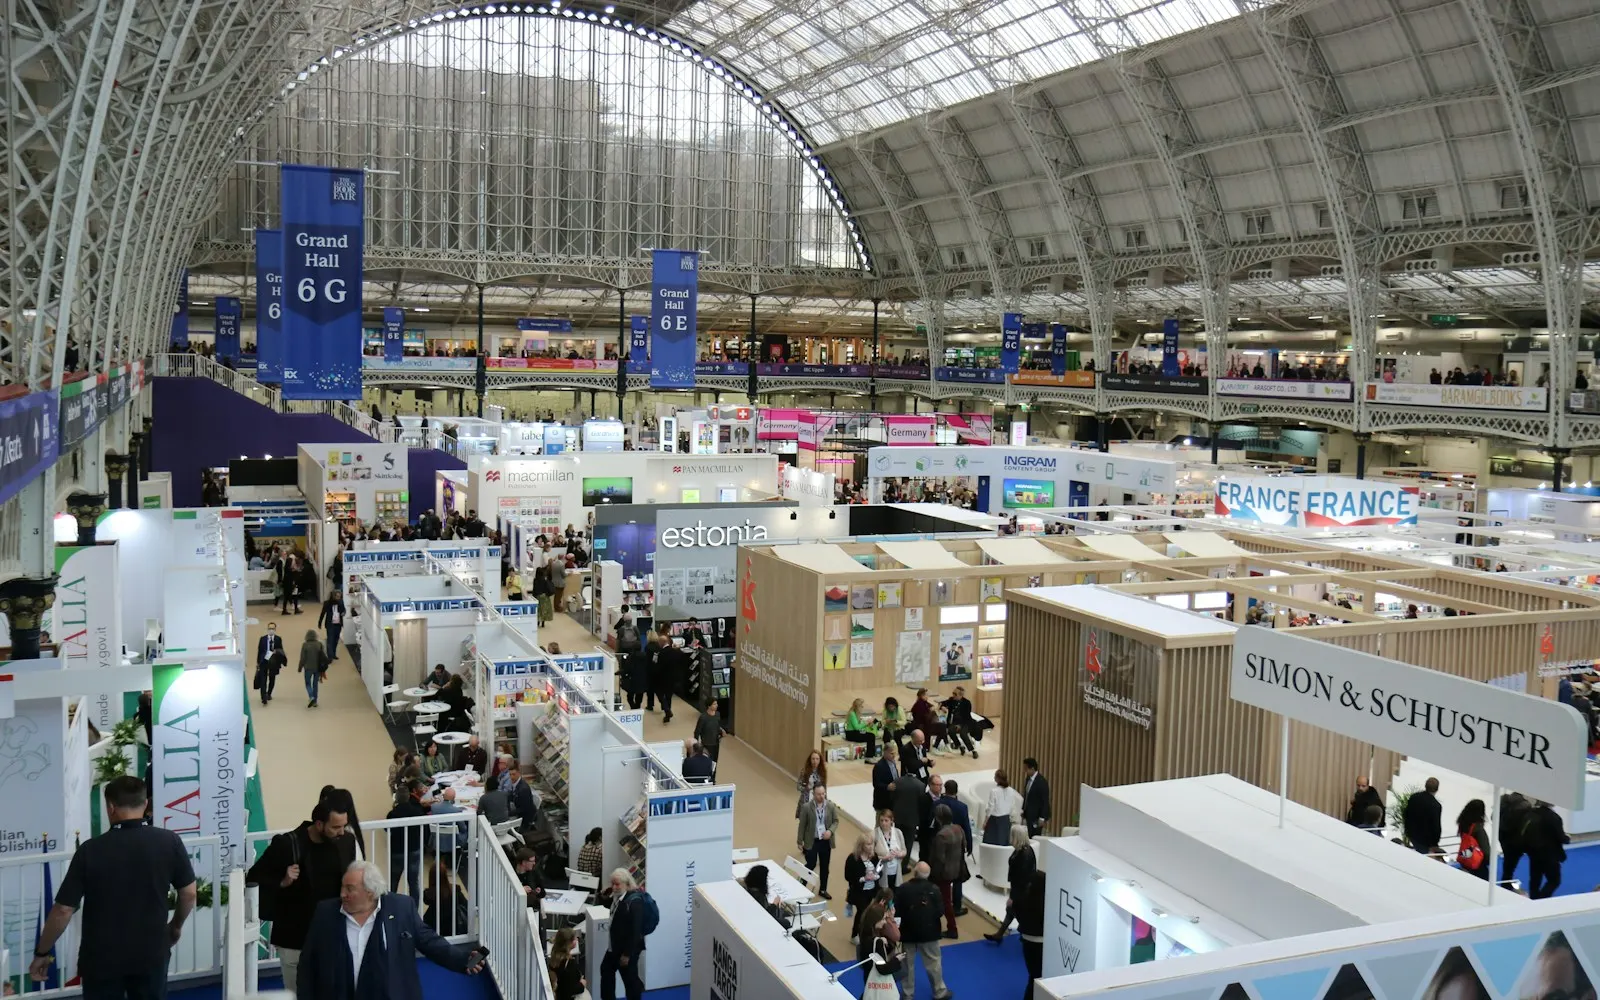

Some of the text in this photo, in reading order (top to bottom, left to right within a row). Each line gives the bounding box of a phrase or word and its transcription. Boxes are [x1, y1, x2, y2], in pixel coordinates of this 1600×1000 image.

[334, 185, 357, 194] BOOK
[333, 193, 357, 201] FAIR
[296, 232, 348, 248] Grand
[305, 253, 340, 268] Hall
[297, 277, 347, 303] 6 G
[660, 289, 689, 298] Grand
[664, 301, 684, 310] Hall
[660, 315, 688, 331] 6 E
[219, 327, 235, 335] 6 G
[1530, 341, 1542, 349] Lift
[1441, 387, 1523, 407] BARAMGILBOOKS
[763, 422, 797, 430] Germany
[890, 427, 927, 439] Germany
[1004, 455, 1057, 468] INGRAM
[508, 469, 575, 482] macmillan
[682, 465, 744, 474] PAN MACMILLAN
[1510, 465, 1523, 473] Lift
[1218, 481, 1300, 514] FRANCE
[1306, 490, 1411, 517] FRANCE
[661, 519, 768, 548] estonia
[351, 563, 404, 571] LLEWELLYN
[62, 575, 88, 664] TALIA
[96, 626, 111, 727] madey.gov.it
[740, 655, 809, 711] Sharjah Book Authority
[499, 678, 532, 691] PGUK
[1083, 694, 1151, 731] Sharjah Book Authority
[1245, 652, 1554, 770] SIMON & SCHUSTER
[620, 714, 642, 723] 6E30
[0, 829, 26, 842] lian
[0, 837, 58, 853] blishing
[684, 860, 697, 969] Publishers Group UK
[712, 936, 738, 986] MANGA
[712, 960, 738, 1000] TAROT
[867, 982, 893, 991] BOOKBAR
